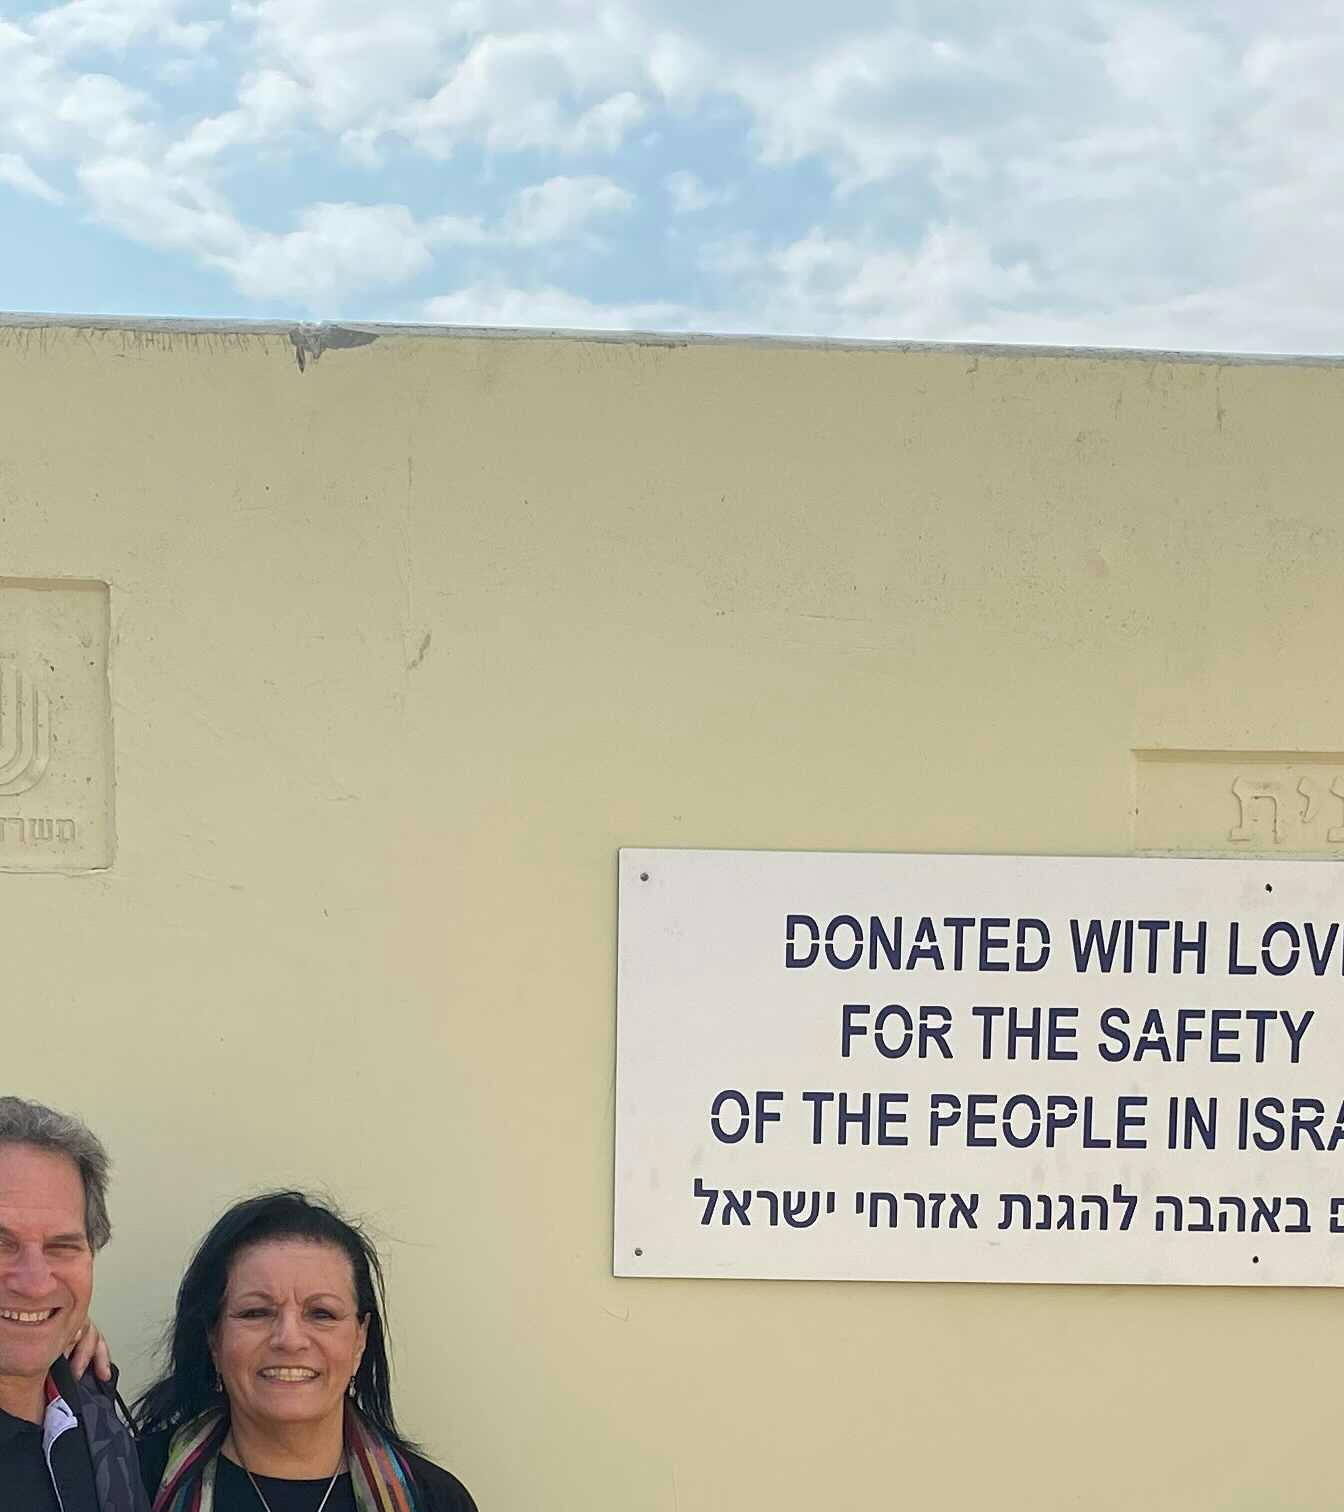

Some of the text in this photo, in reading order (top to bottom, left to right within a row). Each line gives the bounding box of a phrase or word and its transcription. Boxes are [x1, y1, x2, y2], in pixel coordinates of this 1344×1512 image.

[786, 915, 1050, 971] DONATED
[1070, 920, 1207, 974] WITH
[842, 1005, 1314, 1063] FOR THE SAFETY
[711, 1090, 783, 1143] OF
[803, 1092, 908, 1145] THE
[930, 1094, 1147, 1148] PEOPLE
[1168, 1097, 1217, 1149] IN
[694, 1179, 835, 1228] ישראל
[856, 1192, 978, 1229] אזרחי
[998, 1184, 1137, 1230] להגנת
[1156, 1196, 1311, 1232] באהבה
